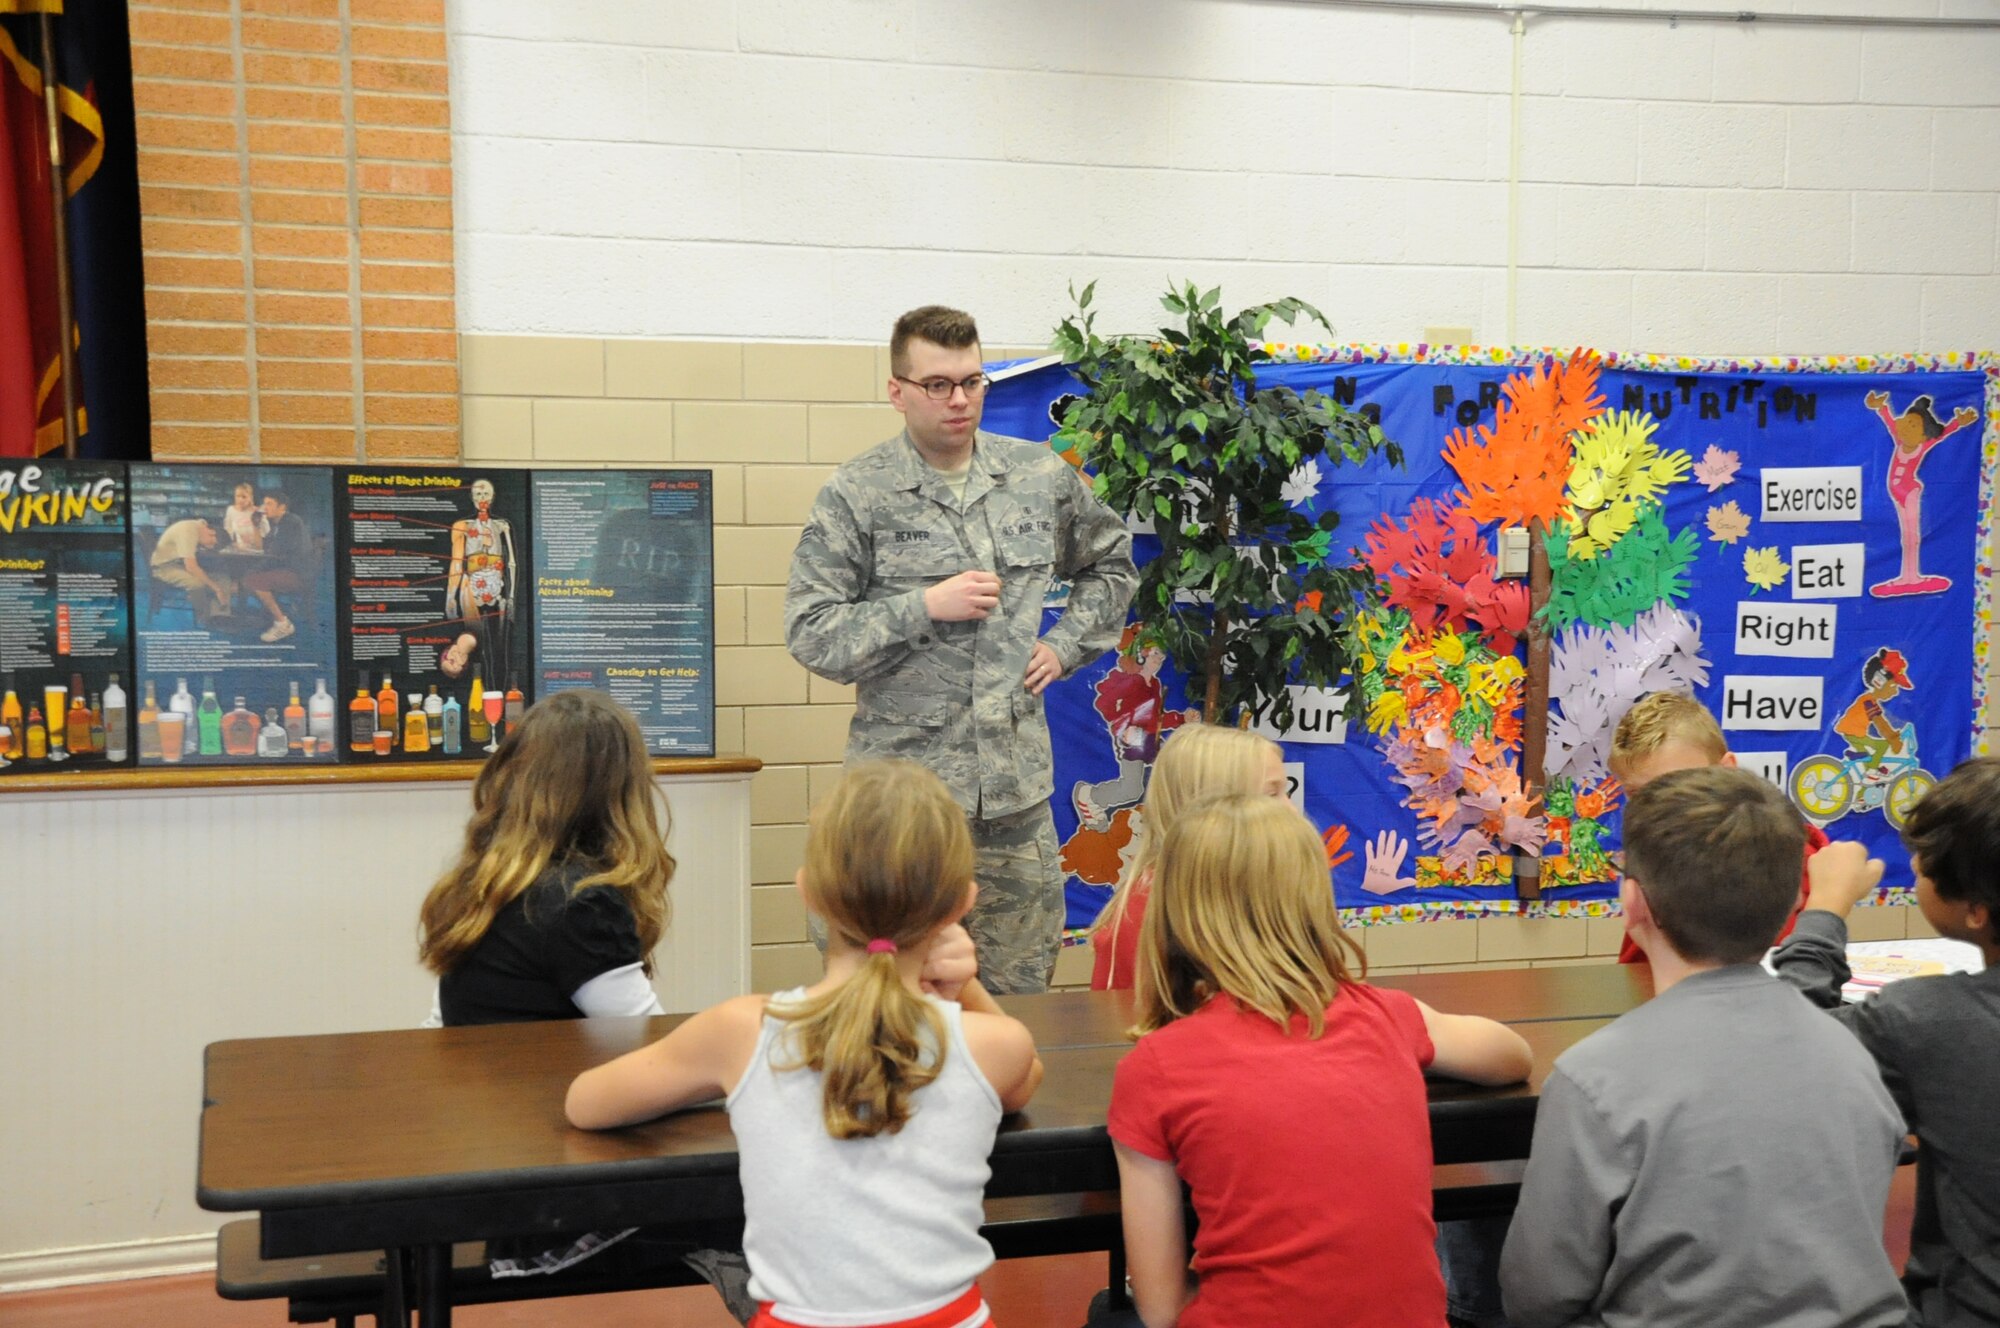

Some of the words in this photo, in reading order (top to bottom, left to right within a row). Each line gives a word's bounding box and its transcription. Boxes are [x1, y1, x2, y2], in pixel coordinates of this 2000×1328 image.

[1433, 381, 1500, 427] FOR
[1623, 376, 1817, 429] NUTRITION
[348, 474, 382, 485] Effects
[383, 475, 394, 485] of
[396, 475, 423, 486] Binge
[423, 476, 462, 488] Drinking
[1766, 480, 1857, 512] Exercise
[895, 530, 930, 542] BEAVER
[1018, 522, 1034, 535] AIR
[538, 577, 563, 587] Facts
[565, 578, 590, 587] about
[1798, 558, 1845, 588] Eat
[537, 587, 571, 597] Alcohol
[572, 587, 615, 598] Poisoning
[1741, 615, 1830, 646] Right
[606, 667, 647, 678] Choosing
[647, 668, 658, 677] to
[659, 667, 675, 678] Get
[1252, 694, 1344, 733] Your
[1727, 689, 1817, 719] Have
